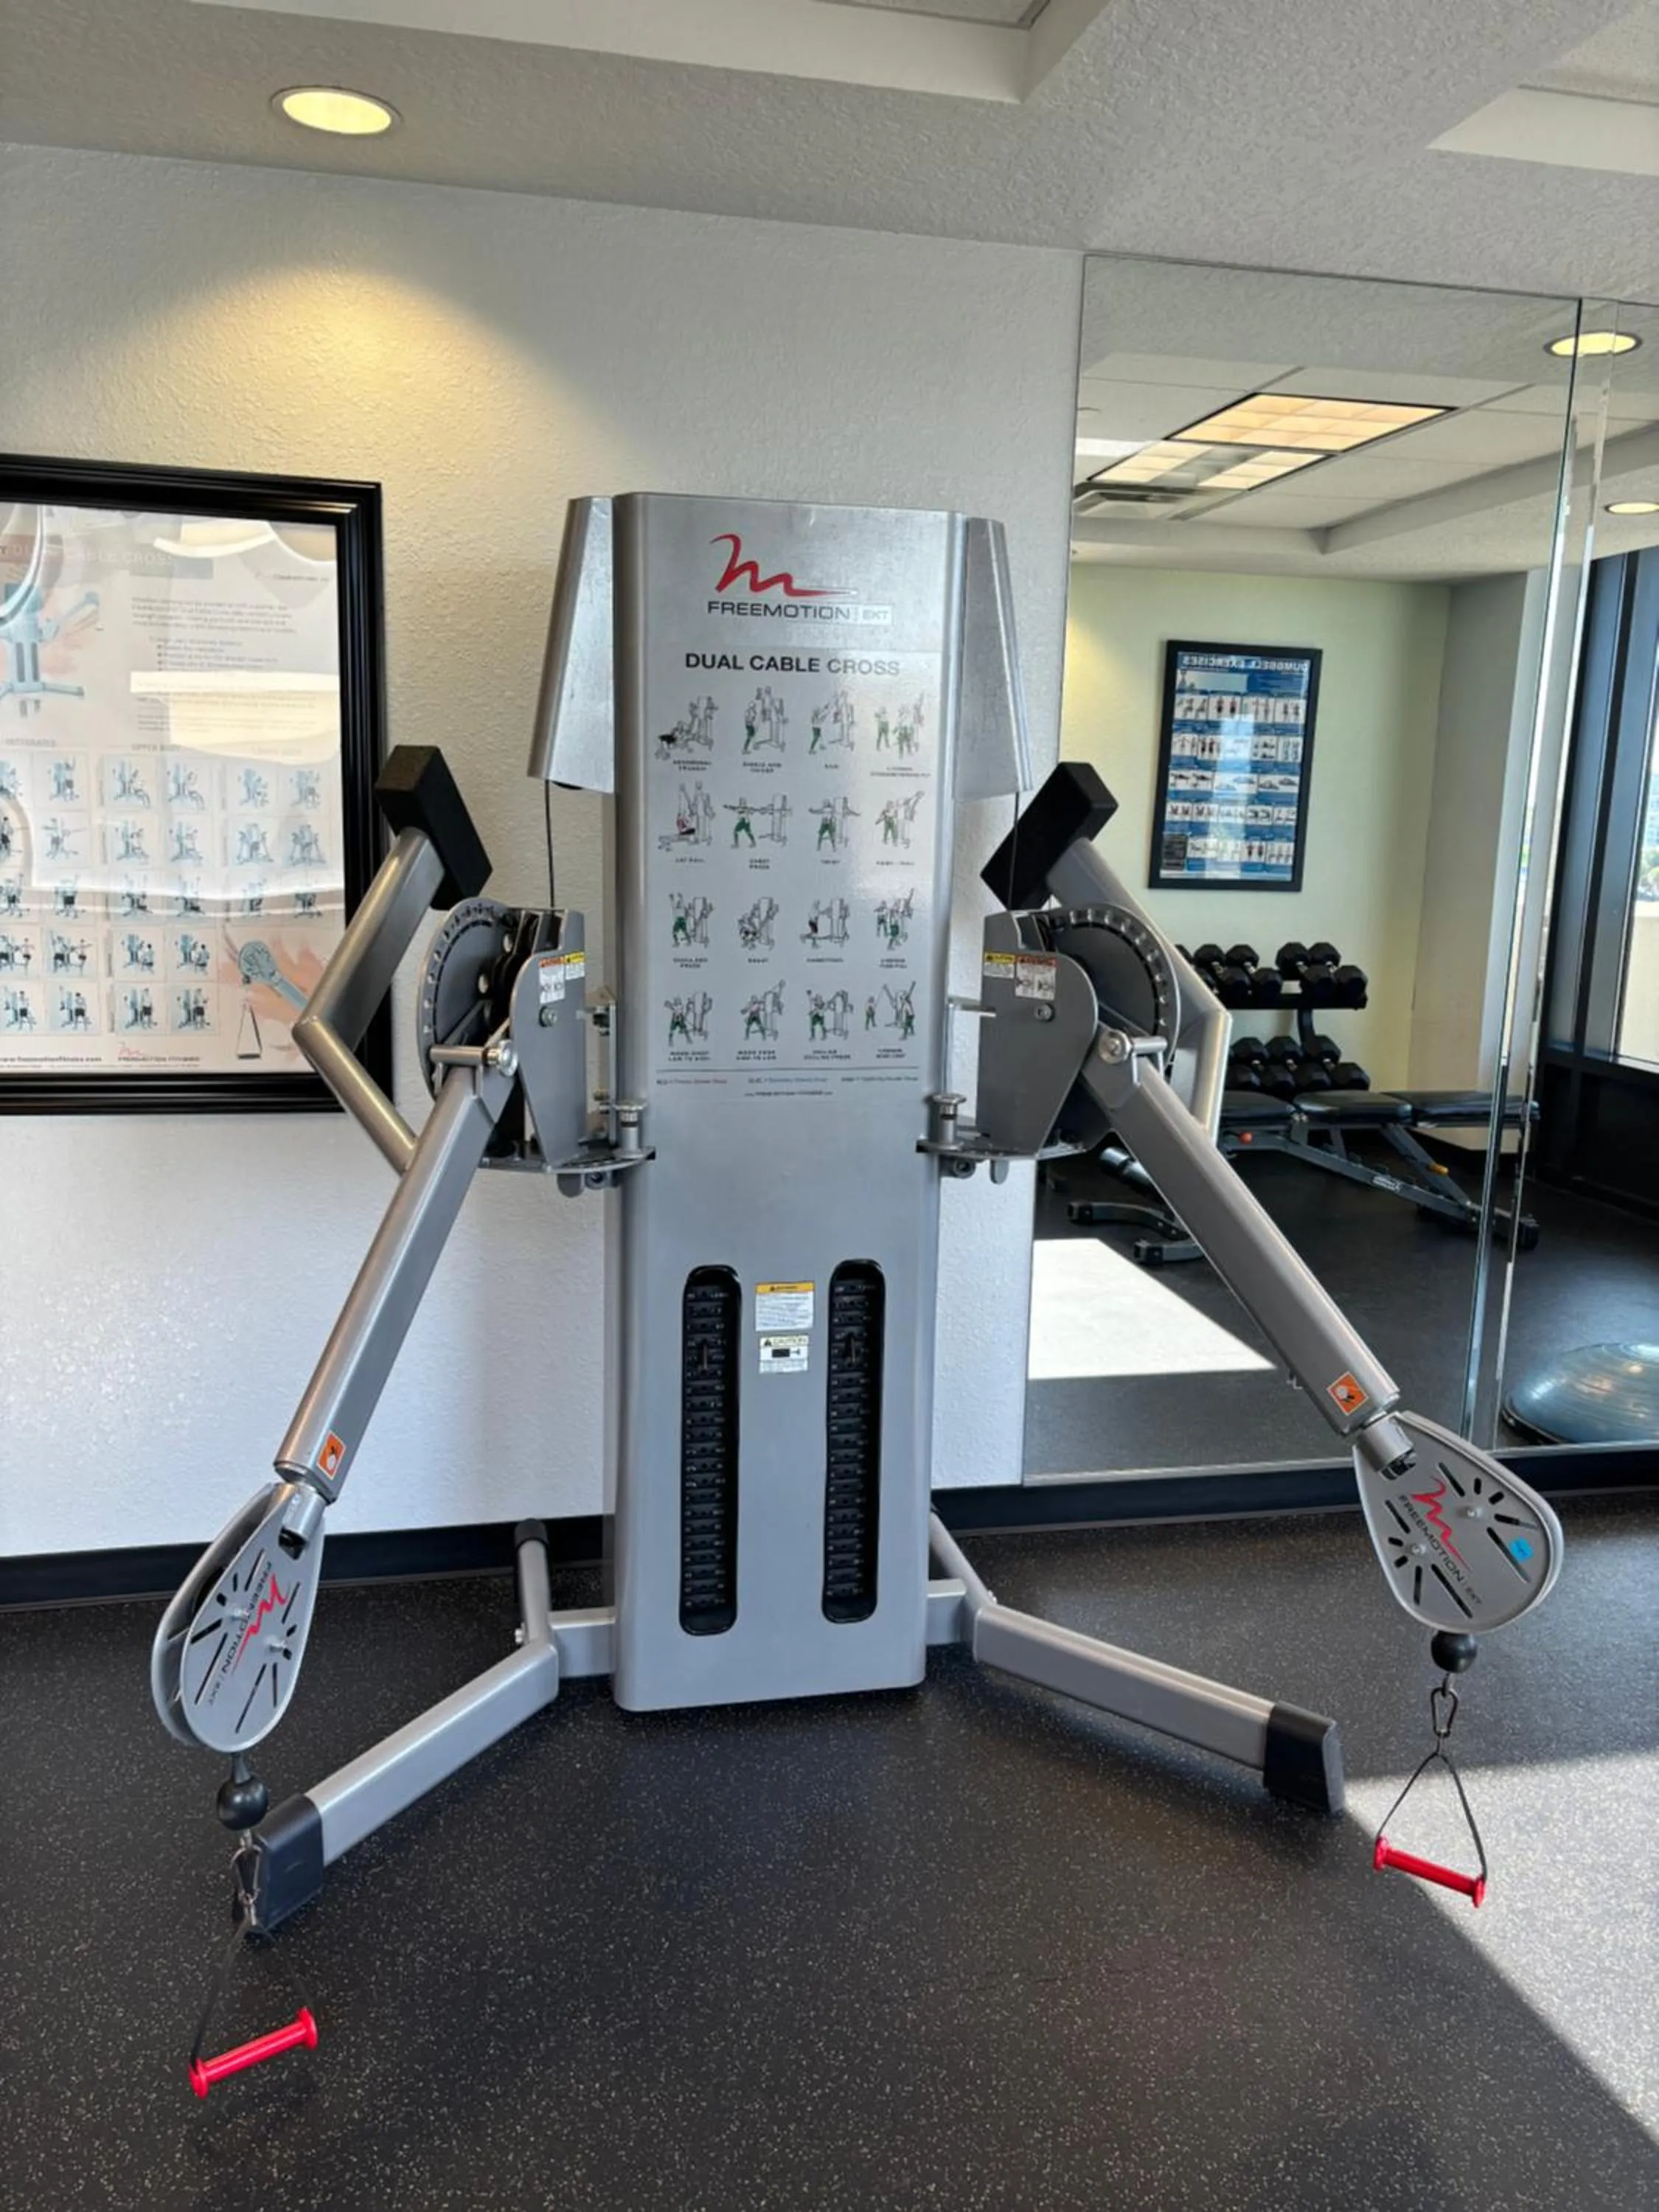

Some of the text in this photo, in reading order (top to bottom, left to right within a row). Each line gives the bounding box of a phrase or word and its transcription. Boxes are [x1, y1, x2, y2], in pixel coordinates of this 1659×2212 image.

[707, 601, 889, 621] FREEMOTION EXT
[686, 653, 900, 676] DUAL CABLE CROSS
[1399, 1495, 1464, 1582] FREEMOTION
